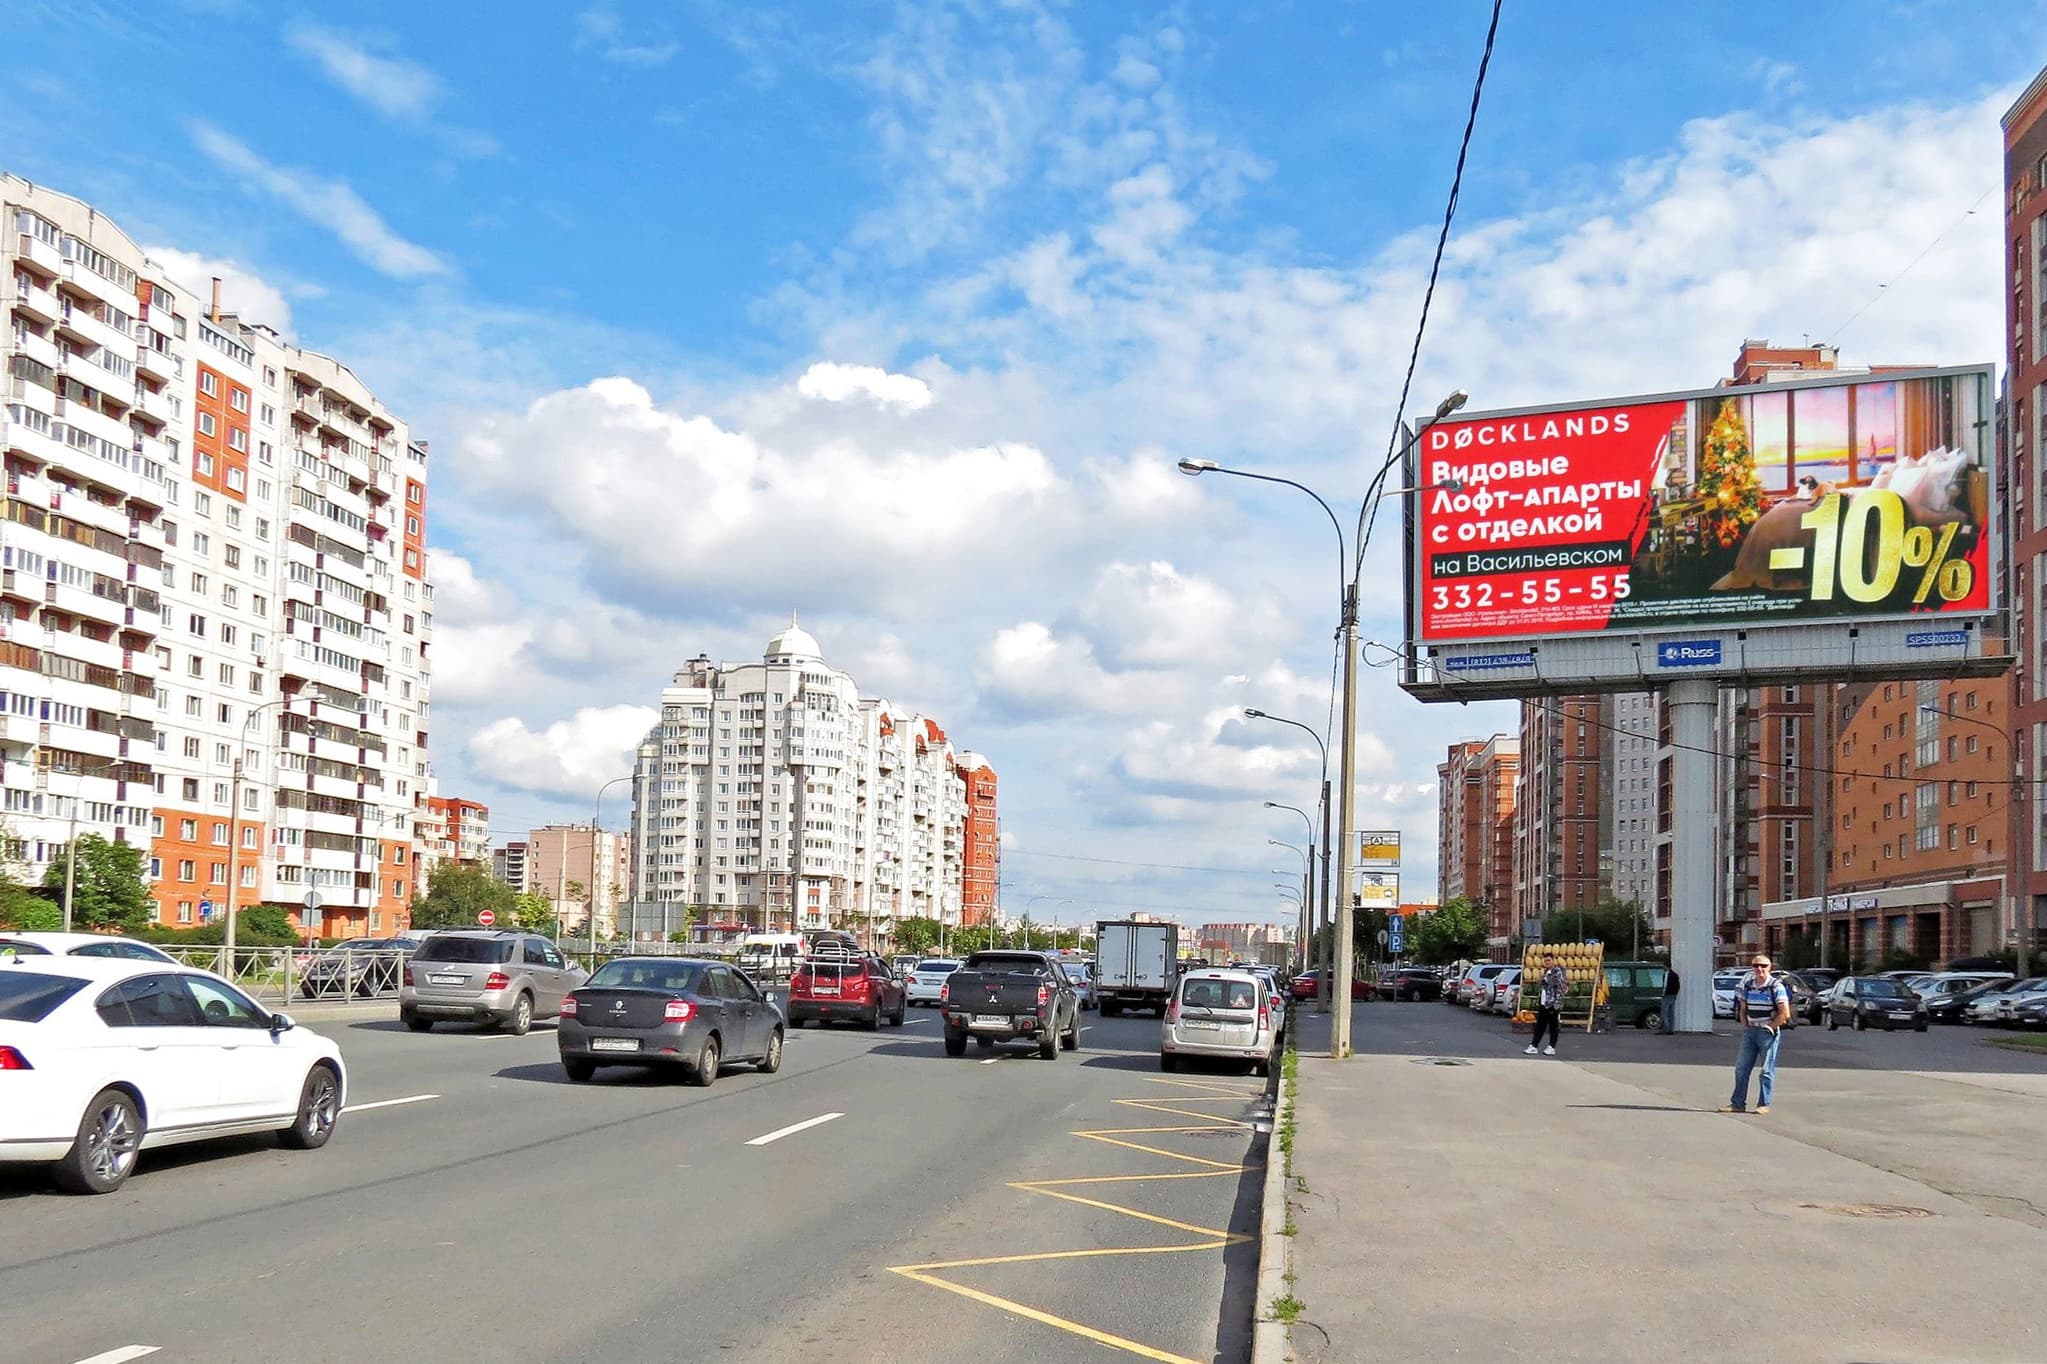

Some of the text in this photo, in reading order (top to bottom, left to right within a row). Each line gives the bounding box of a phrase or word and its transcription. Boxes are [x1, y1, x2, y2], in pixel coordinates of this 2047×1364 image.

[1432, 456, 1569, 486] Видовые
[1431, 479, 1641, 517] Лофт-апарты
[1432, 507, 1603, 543] с отделкой
[1434, 548, 1623, 575] на Васильевском
[1769, 488, 1973, 603] -10%
[1681, 647, 1715, 659] Russ
